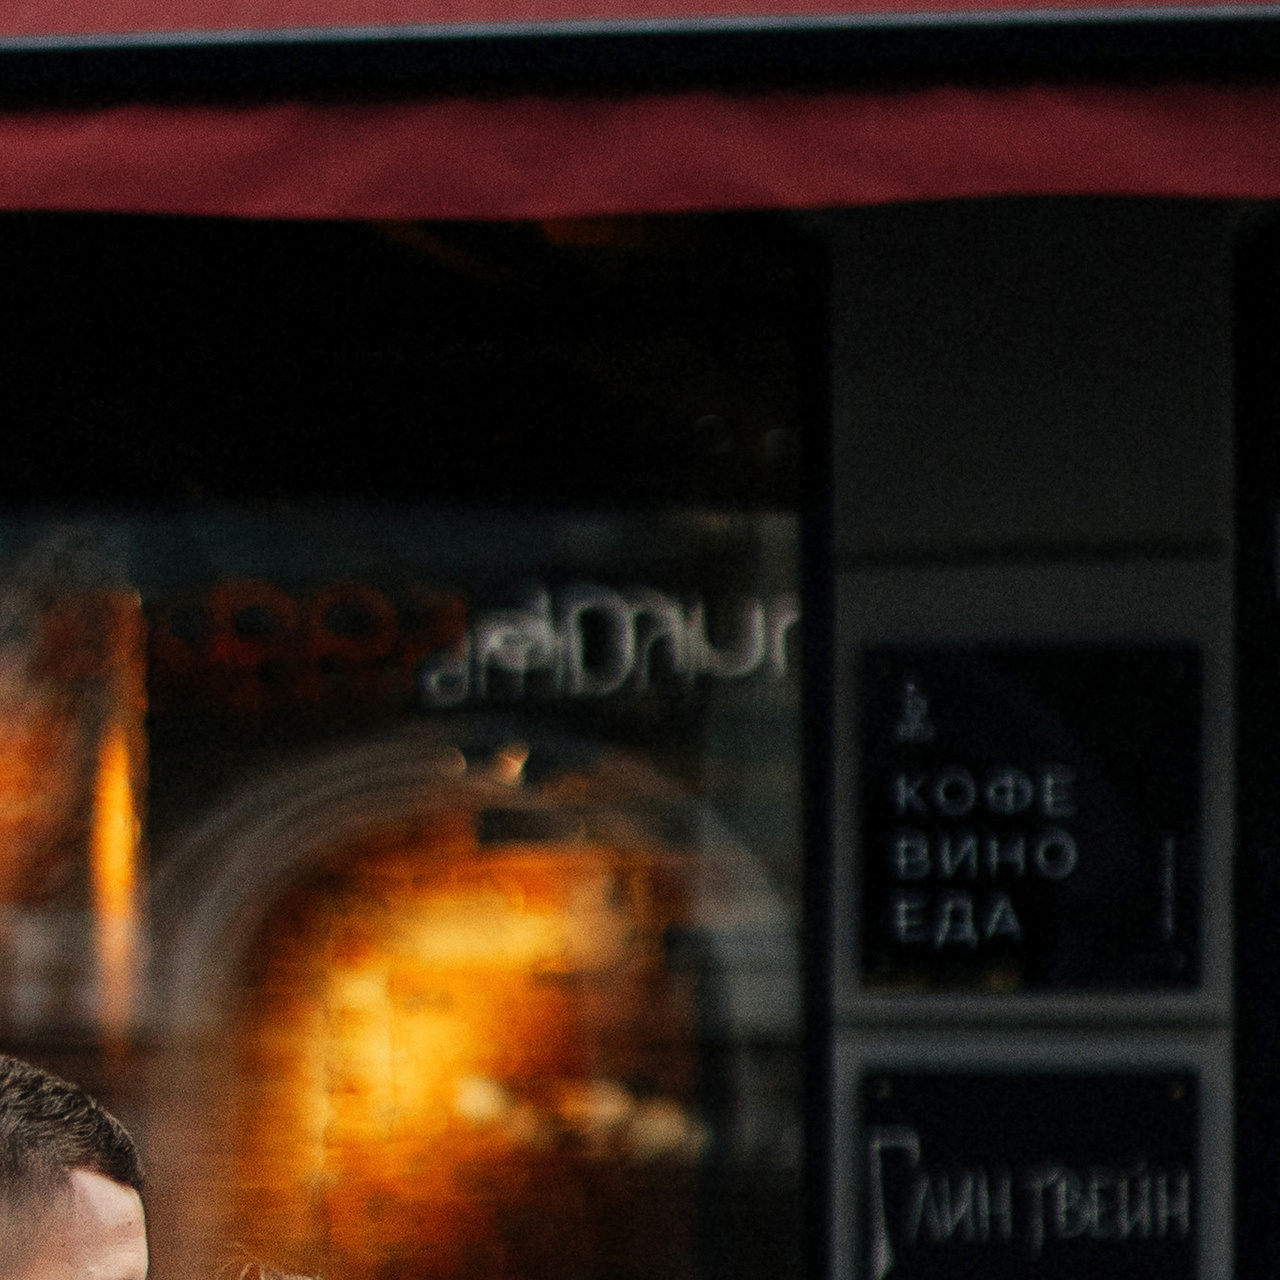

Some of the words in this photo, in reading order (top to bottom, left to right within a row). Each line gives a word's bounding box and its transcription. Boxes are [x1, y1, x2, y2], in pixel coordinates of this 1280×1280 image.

[893, 764, 1079, 818] КОФЕ
[892, 827, 1079, 880] ВИНО
[892, 889, 1022, 950] ЕДА
